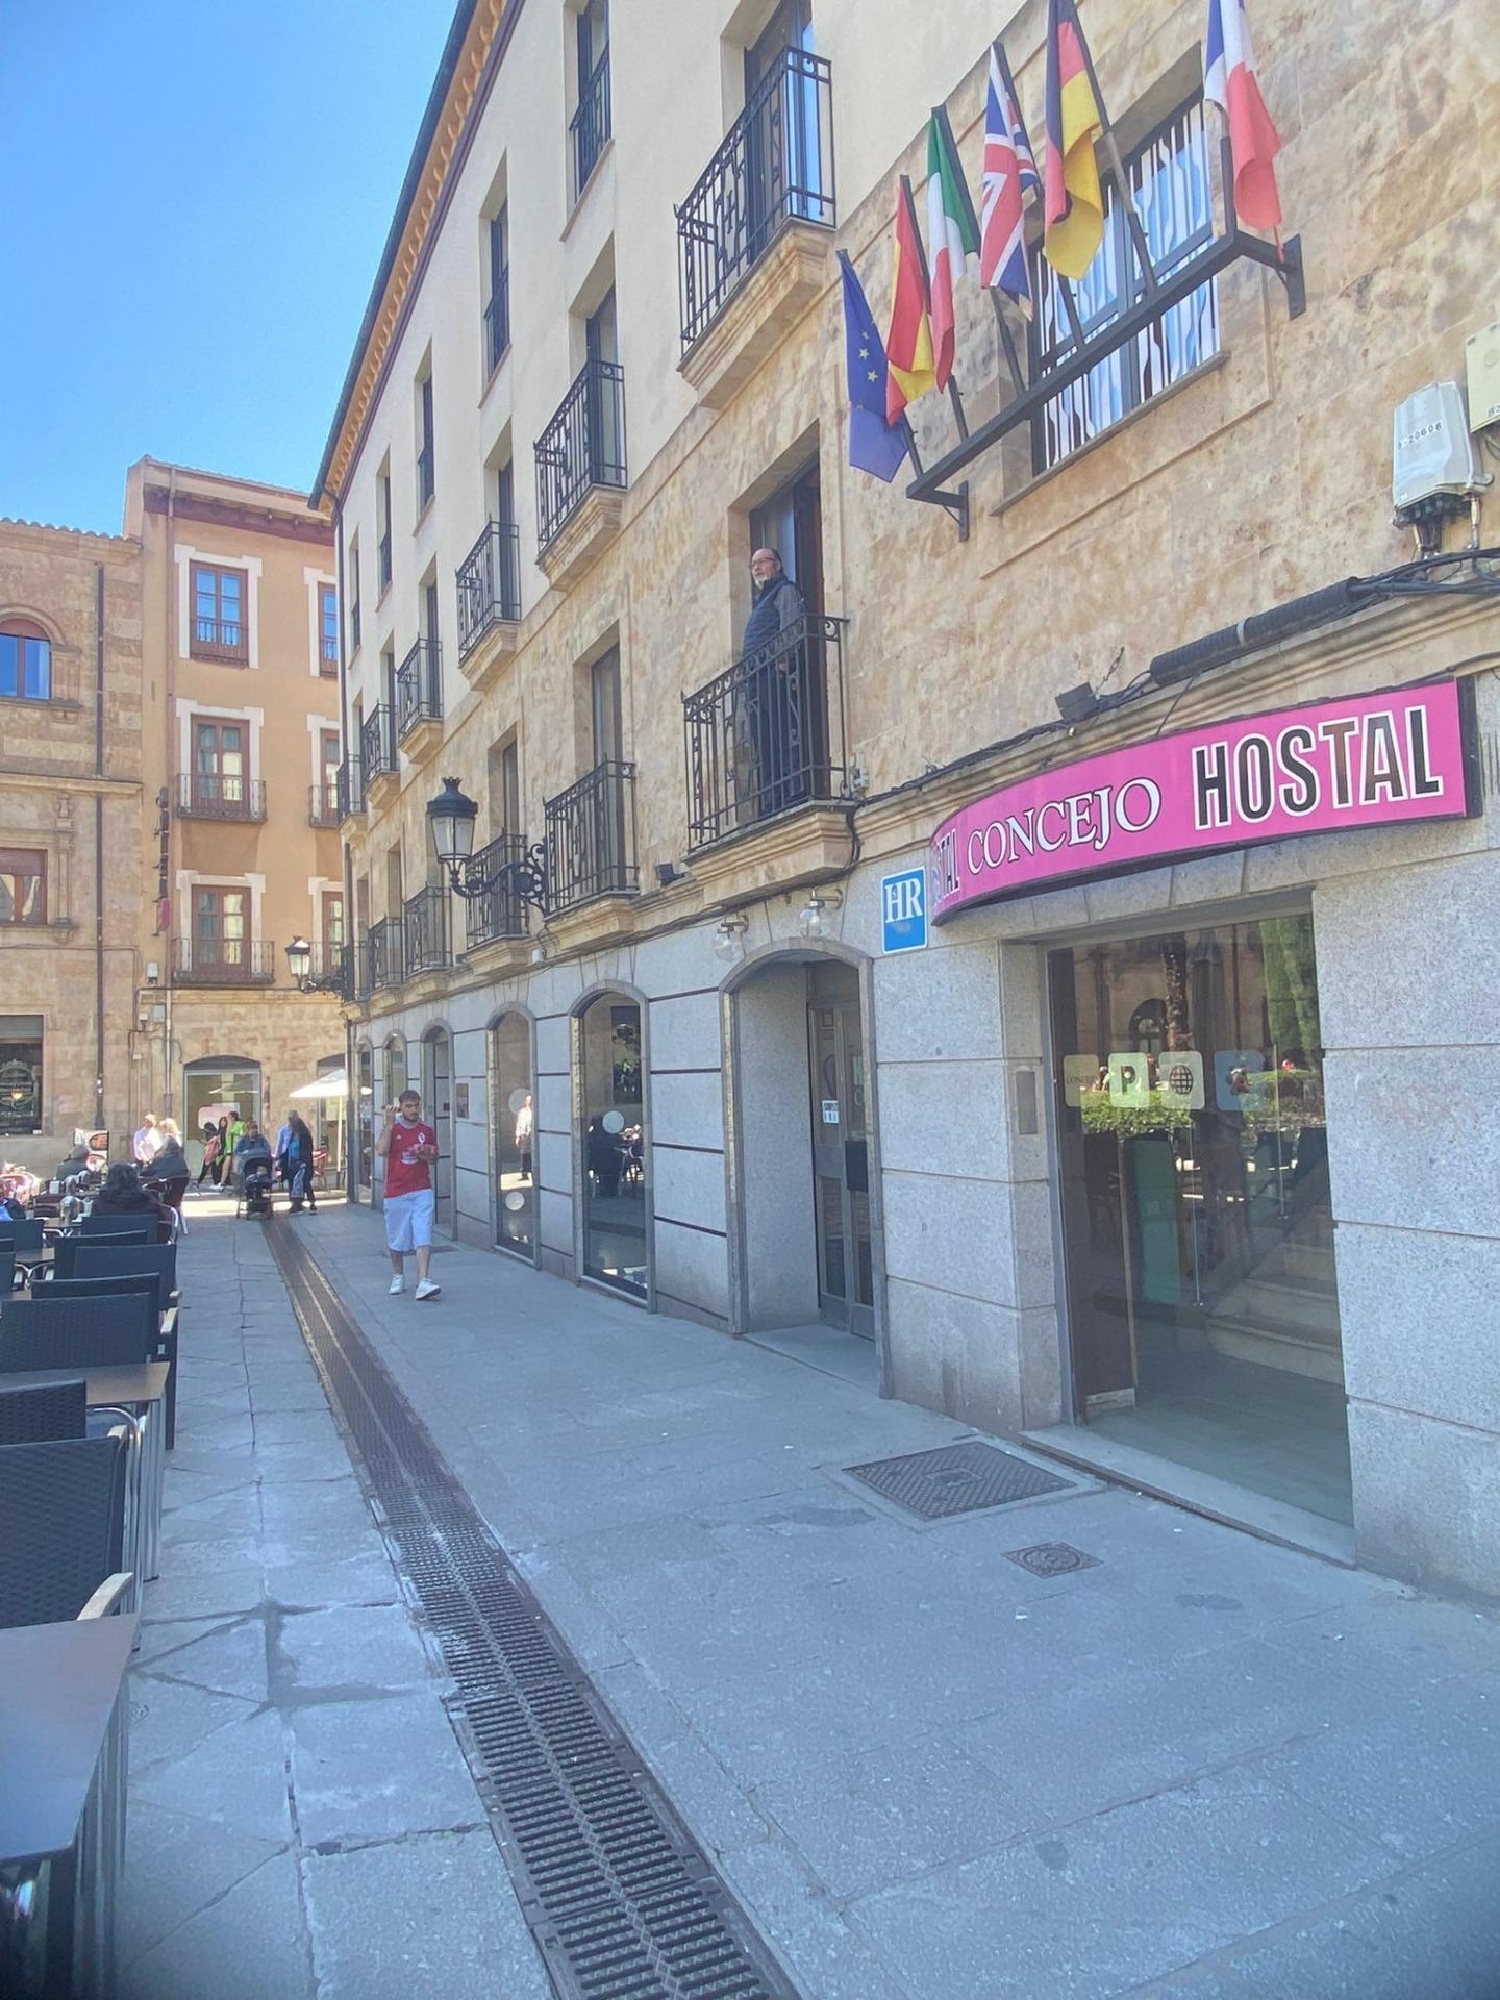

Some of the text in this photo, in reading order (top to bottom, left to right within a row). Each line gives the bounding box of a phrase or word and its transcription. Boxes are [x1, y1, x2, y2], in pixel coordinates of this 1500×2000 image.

[967, 778, 1161, 875] CONCEJO
[1193, 704, 1444, 830] HOSTAL
[884, 877, 923, 923] HR
[1120, 1066, 1136, 1095] P
